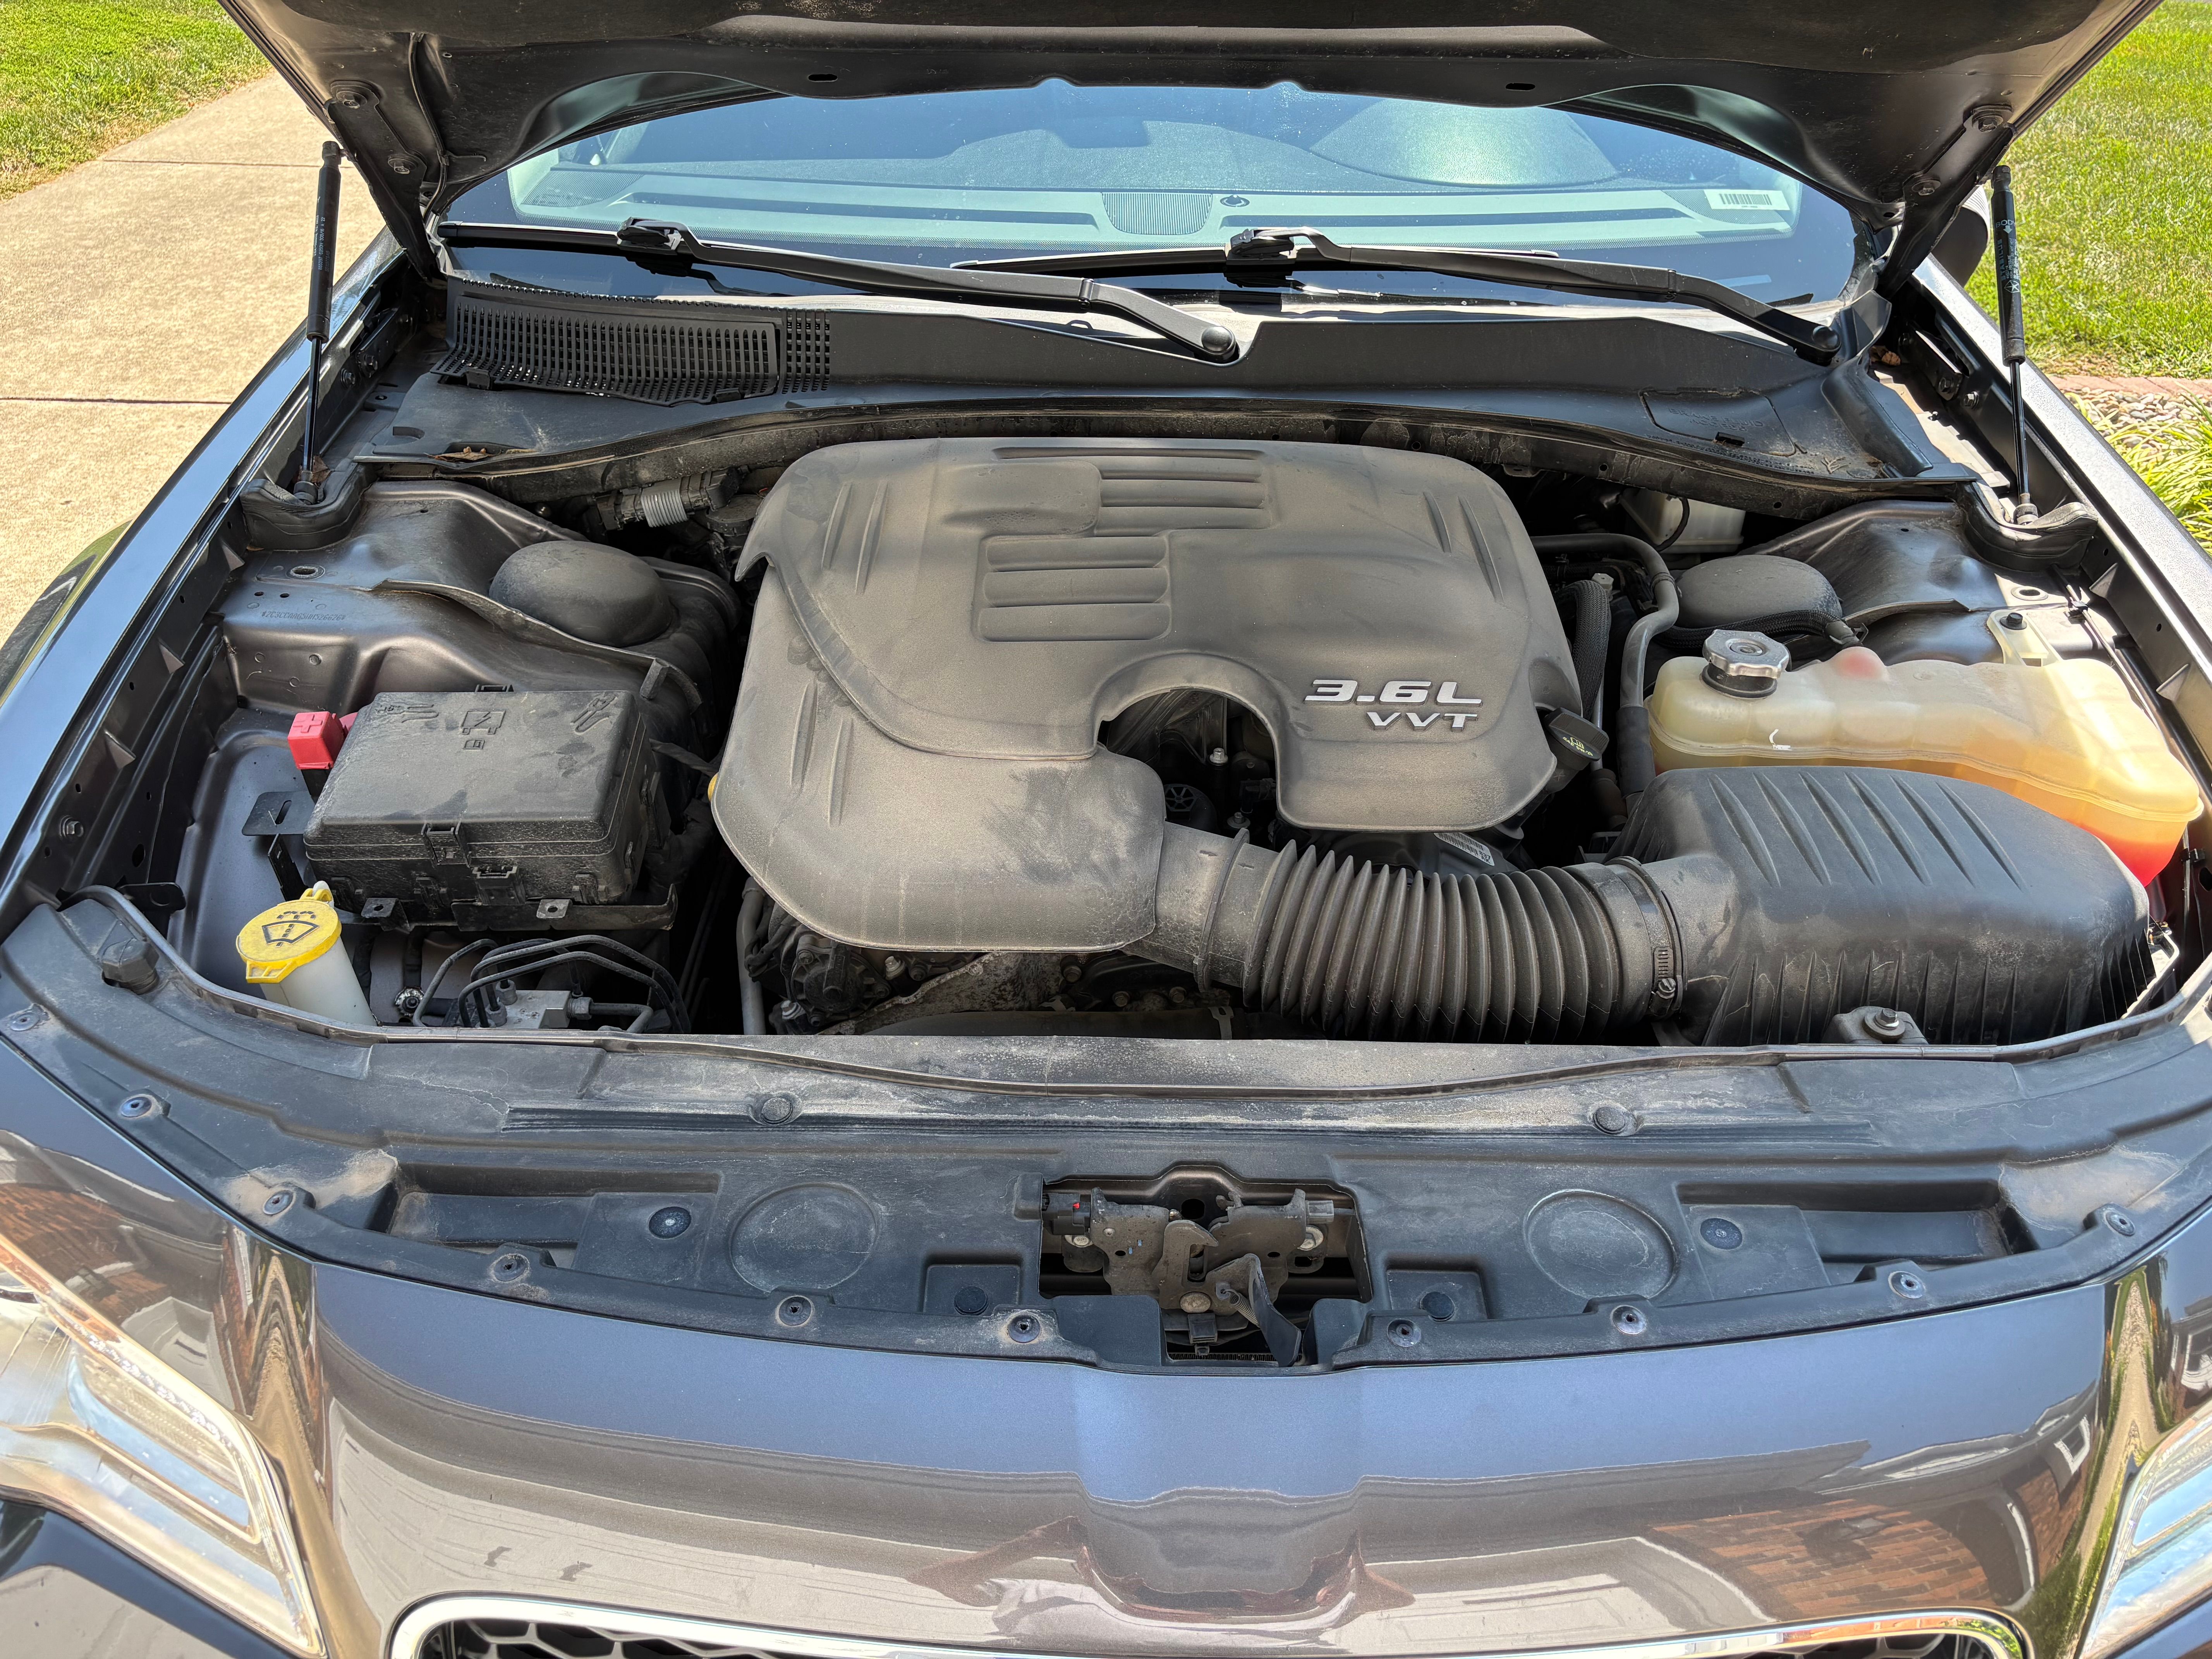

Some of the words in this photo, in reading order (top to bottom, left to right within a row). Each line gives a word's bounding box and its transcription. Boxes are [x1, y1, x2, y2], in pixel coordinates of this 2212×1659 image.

[1996, 219, 2015, 228] BODY
[1304, 679, 1482, 705] 3.6L
[1366, 712, 1478, 731] VVT
